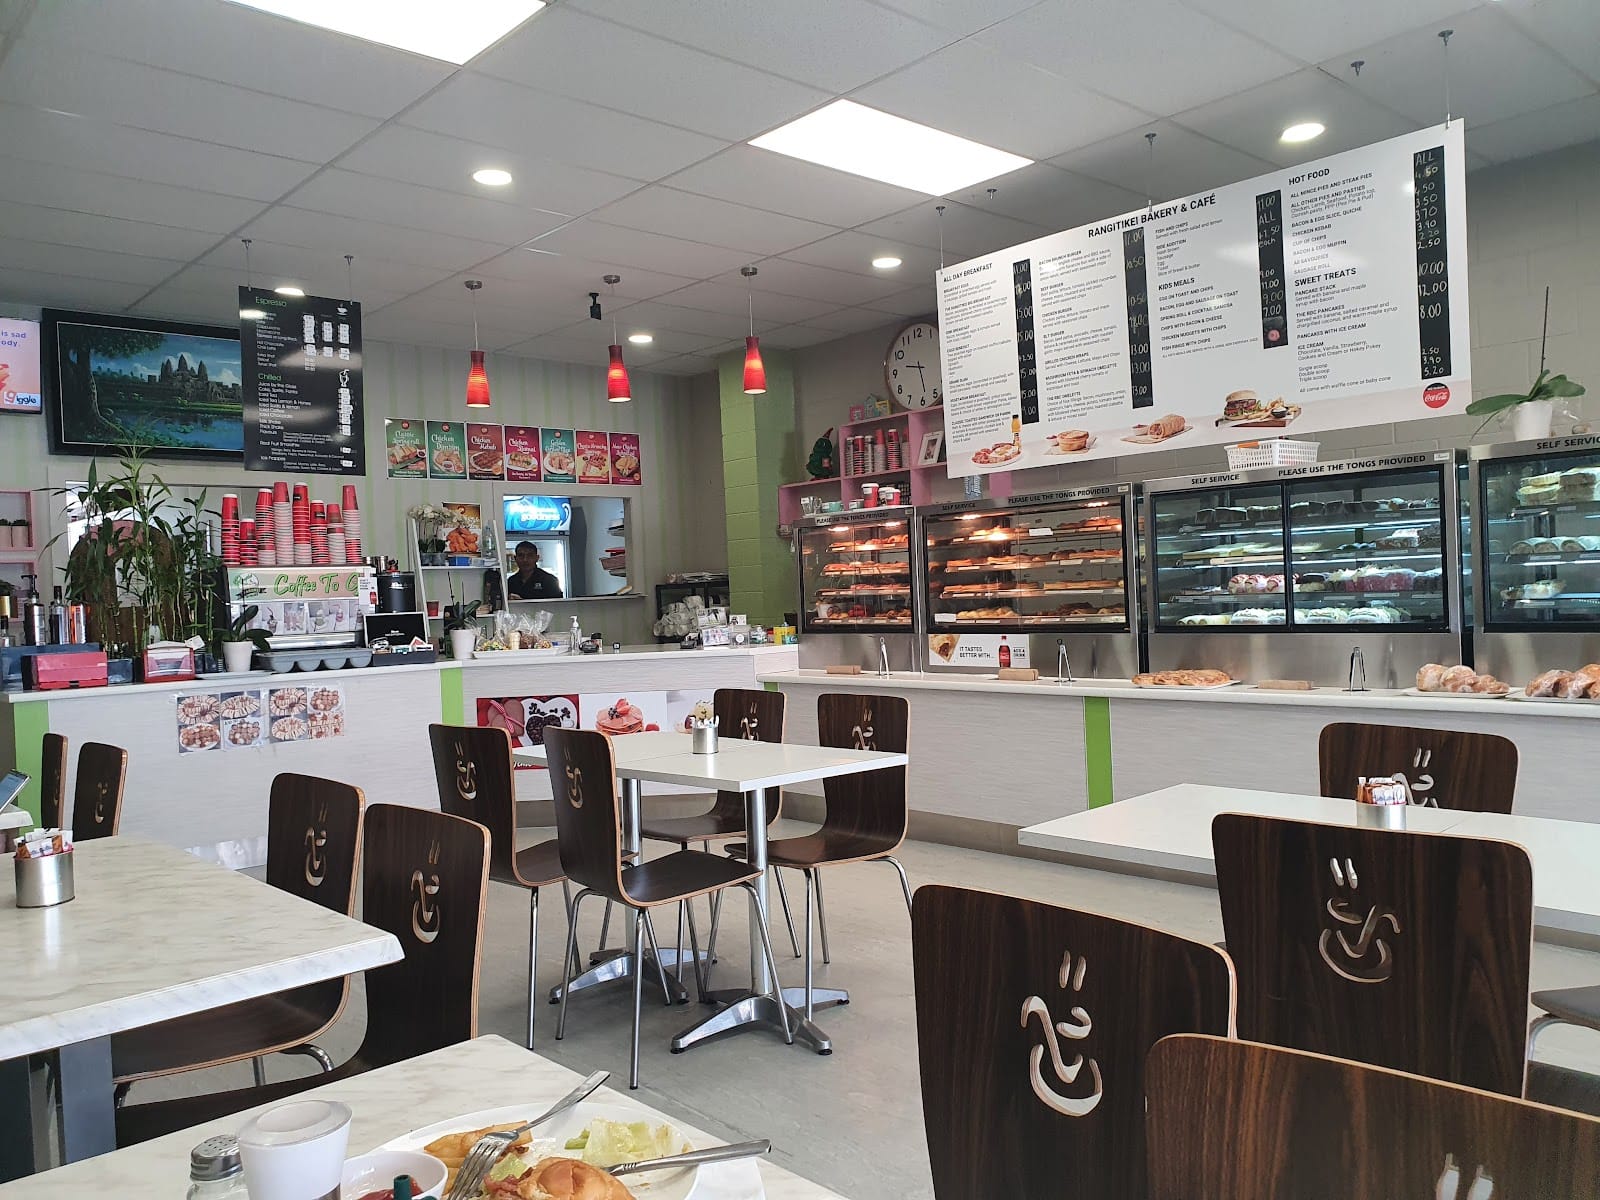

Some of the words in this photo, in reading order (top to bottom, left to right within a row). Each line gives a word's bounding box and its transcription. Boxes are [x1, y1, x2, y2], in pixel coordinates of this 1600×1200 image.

[1289, 174, 1304, 185] HOT
[1308, 168, 1329, 180] FOOD
[1342, 176, 1358, 184] STEAK
[1343, 185, 1365, 194] PASTIES
[1088, 217, 1138, 238] RANGITIKEI
[1141, 205, 1177, 223] BAKERY
[1181, 203, 1187, 212] &
[1190, 192, 1215, 209] CAFÉ
[1342, 206, 1361, 215] QUICHE
[1259, 212, 1275, 225] ALL
[1418, 238, 1440, 250] 2.50
[964, 263, 992, 276] BREAKFAST
[1174, 277, 1194, 287] MEALS
[1294, 275, 1321, 287] SWEET
[1325, 268, 1356, 280] TREATS
[1295, 288, 1318, 296] PANCAKE
[255, 297, 286, 307] Espresso
[1420, 303, 1441, 319] 8.00
[913, 328, 922, 338] 12
[1297, 331, 1323, 339] PANCAKES
[902, 336, 910, 346] 11
[895, 350, 904, 360] 10
[1422, 347, 1439, 356] 2.50
[1424, 356, 1441, 364] 3.90
[892, 369, 897, 378] 9
[1424, 366, 1444, 376] 5.20
[898, 384, 902, 394] 8
[933, 389, 938, 398] 5
[908, 395, 912, 405] 7
[920, 396, 925, 406] 6
[432, 434, 454, 443] Chicken
[471, 436, 491, 444] Chicken
[509, 438, 528, 447] Chicken
[1537, 440, 1560, 449] SELF
[1564, 437, 1600, 446] SERVIC
[1278, 468, 1306, 477] PLEASE
[1346, 460, 1376, 469] TONGS
[1379, 455, 1426, 466] PROVIDED
[1192, 476, 1207, 484] SELF
[1210, 474, 1240, 482] SERVICE
[1056, 491, 1076, 499] TONGS
[1078, 488, 1110, 497] PROVIDED
[274, 574, 317, 596] Coffee
[319, 573, 339, 593] To
[346, 572, 359, 596] G
